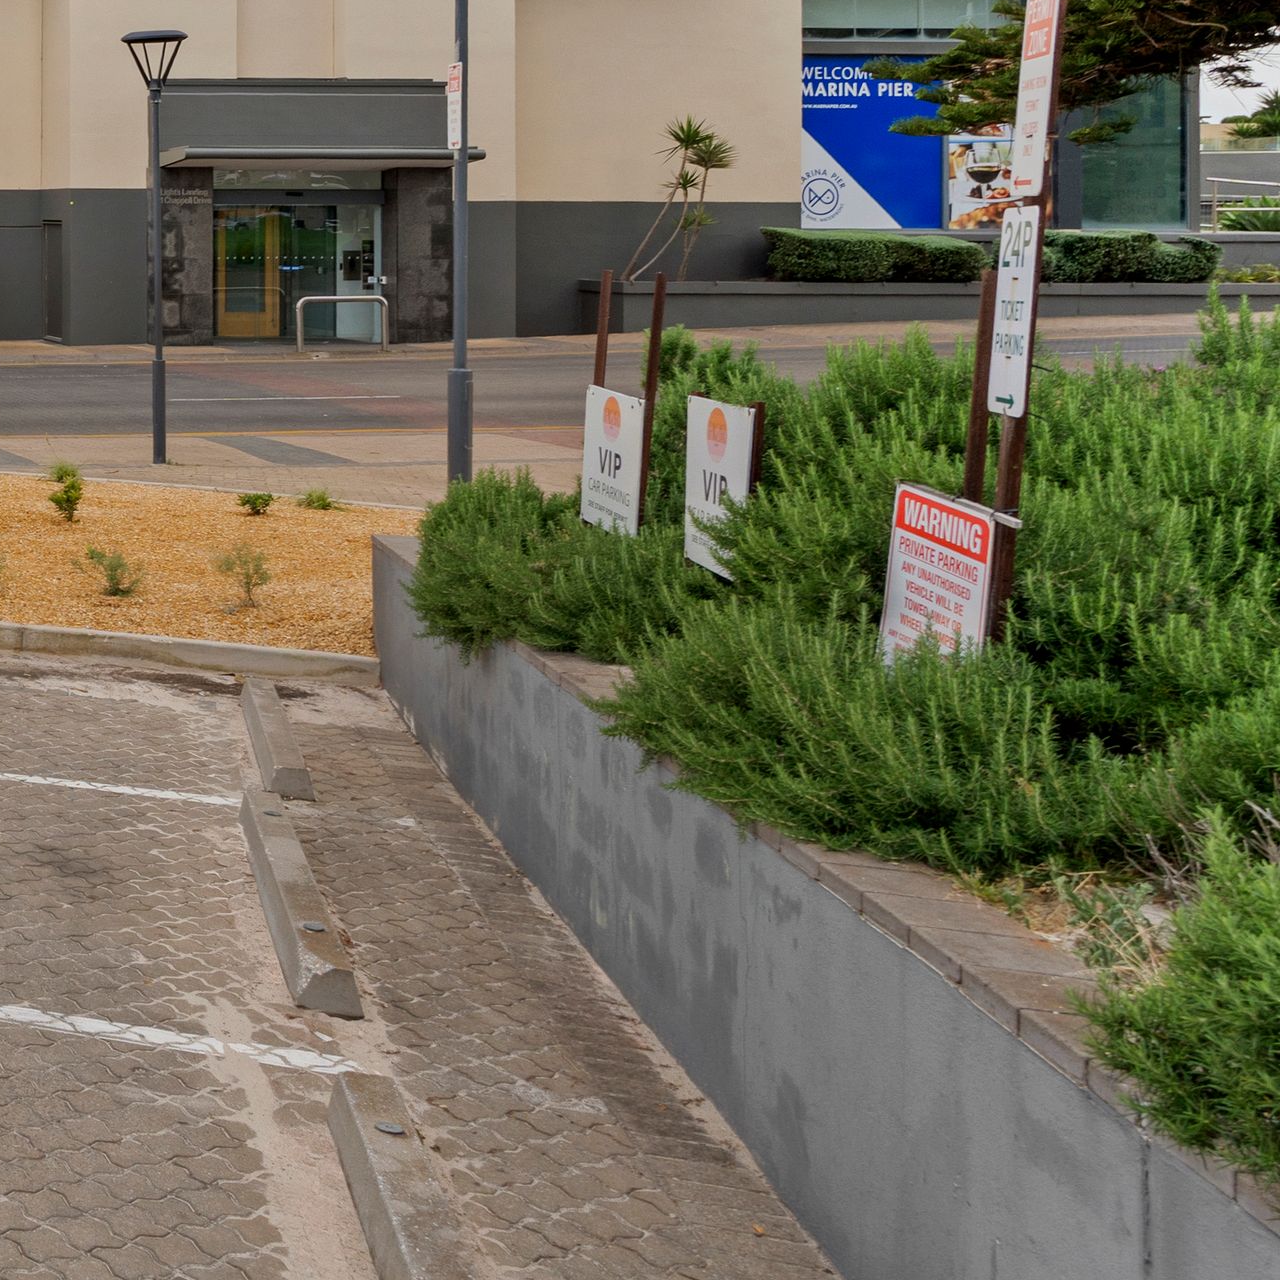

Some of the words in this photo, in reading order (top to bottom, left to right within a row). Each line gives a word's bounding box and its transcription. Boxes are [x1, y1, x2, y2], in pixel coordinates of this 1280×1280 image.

[1027, 27, 1049, 56] ZONE
[801, 66, 874, 80] WELCOM
[801, 81, 871, 97] MARINA
[877, 81, 914, 97] PIER
[1002, 221, 1033, 268] 24P
[1001, 299, 1025, 322] TICKET
[993, 332, 1025, 356] PARKING
[599, 446, 622, 480] VIP
[588, 477, 601, 495] CAR
[601, 482, 631, 508] PARKING
[702, 469, 728, 506] VIP
[904, 497, 983, 555] WARNING
[899, 535, 936, 564] PRIVATE
[937, 551, 979, 583] PARKING
[901, 560, 916, 575] ANY
[917, 566, 971, 601] UNAUTHORISED
[904, 596, 929, 617] TOWED
[930, 609, 951, 628] AWAY
[905, 579, 935, 603] VEHICLE
[935, 593, 952, 612] WILL
[953, 602, 964, 617] BE
